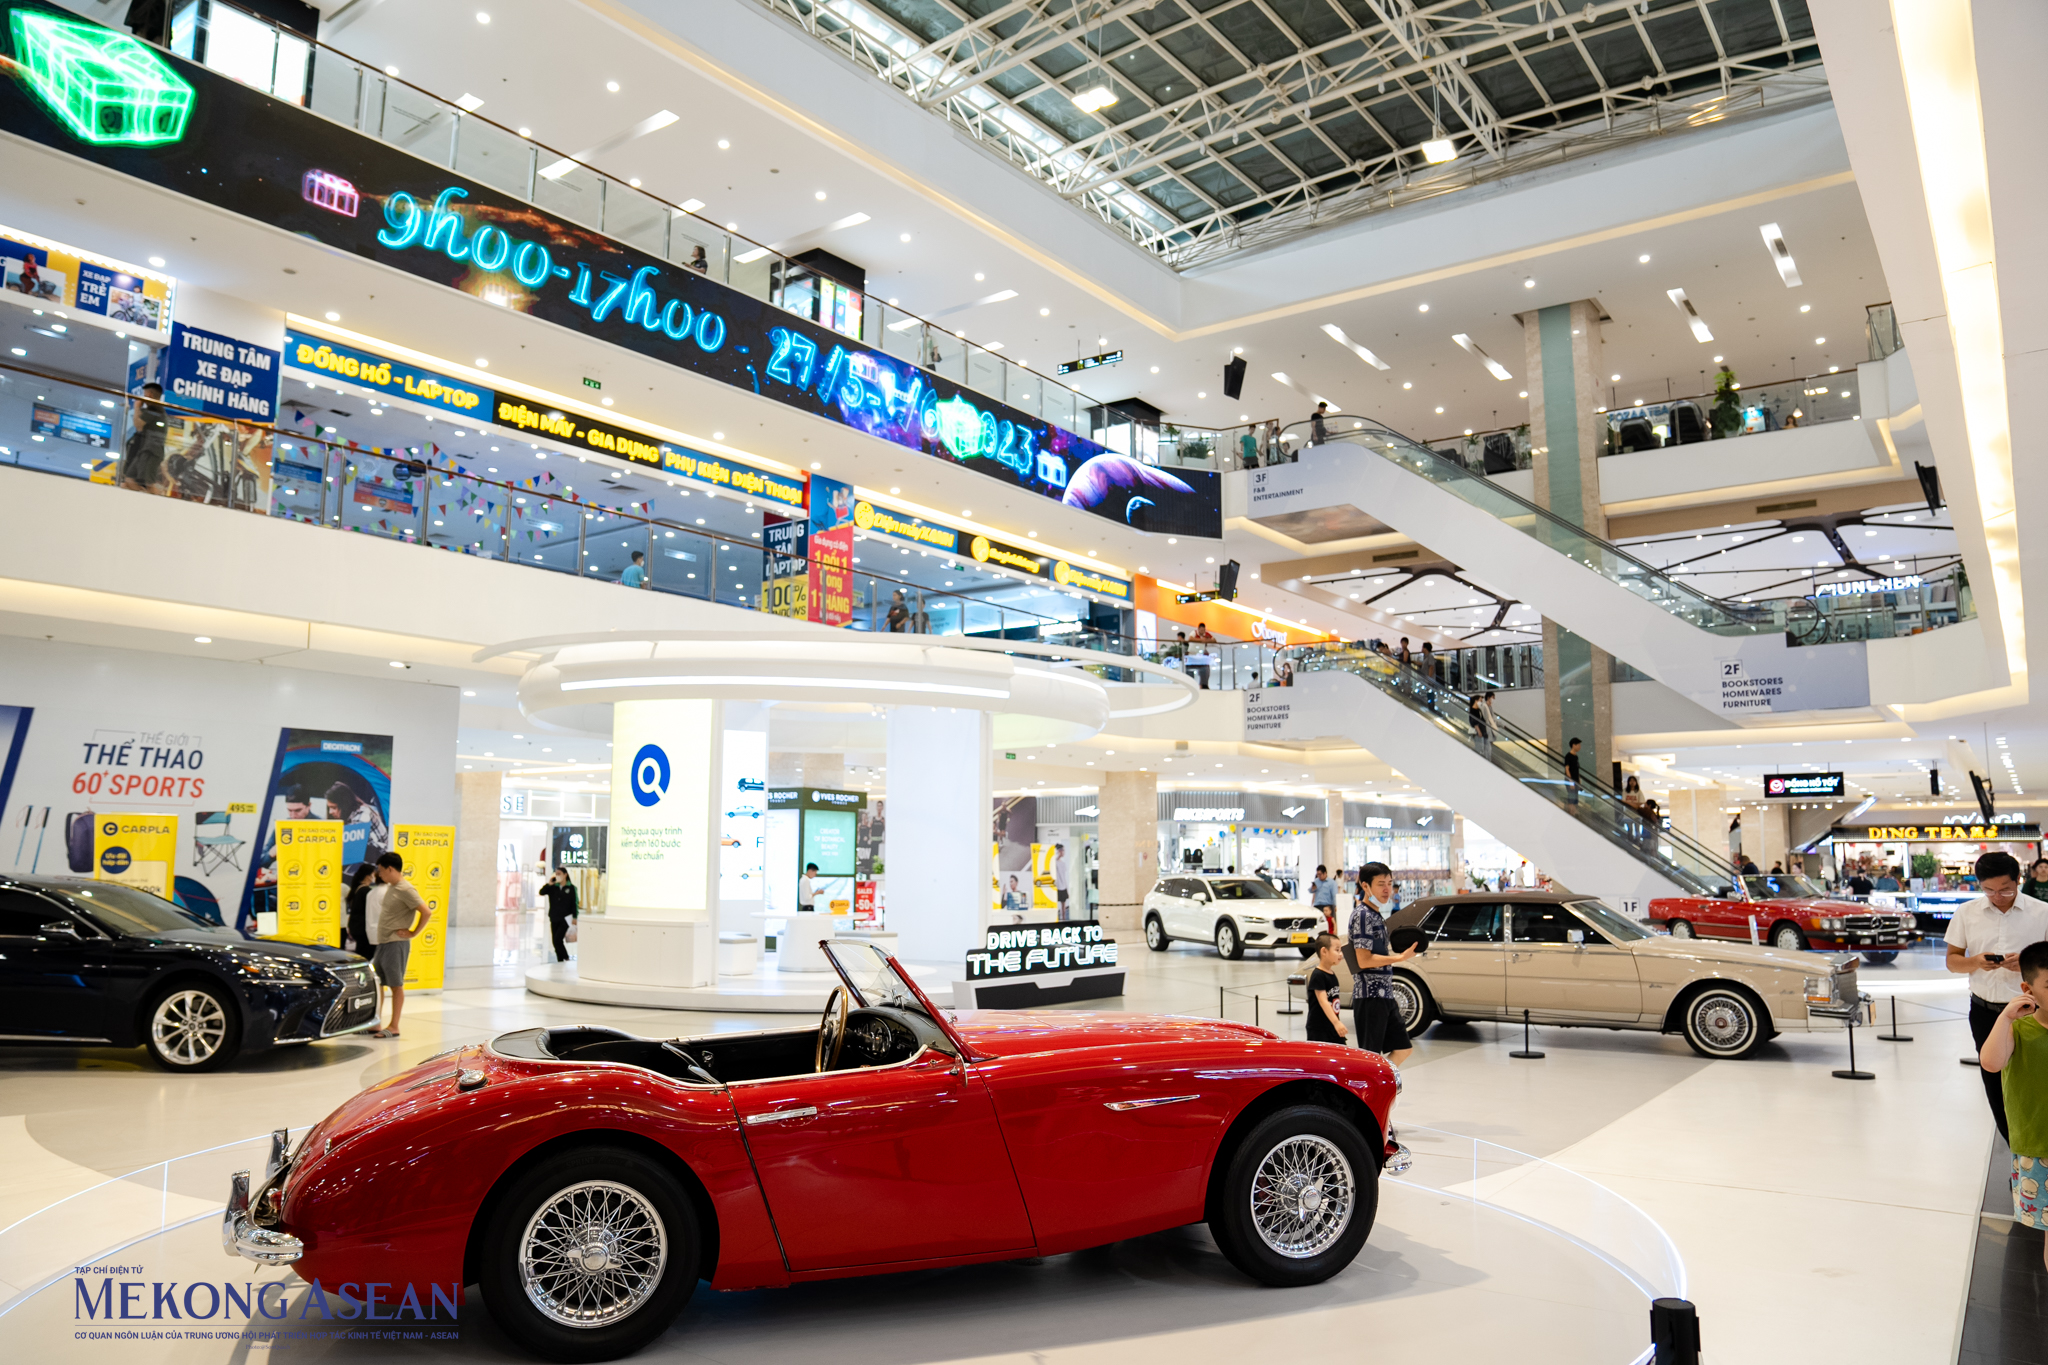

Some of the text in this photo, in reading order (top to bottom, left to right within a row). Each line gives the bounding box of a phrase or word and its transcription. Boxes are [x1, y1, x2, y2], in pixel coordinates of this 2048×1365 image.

[81, 280, 107, 297] TRẺ
[80, 292, 100, 307] EM
[181, 331, 271, 371] TRUNG TÂM
[197, 360, 253, 388] XE ĐẠP
[296, 343, 360, 378] ĐỒNG
[360, 362, 392, 386] HỒ
[405, 375, 480, 410] LAPTOP
[173, 376, 224, 405] CHÍNH
[227, 391, 269, 417] HÃNG
[498, 402, 540, 429] ĐIỆN
[540, 413, 576, 439] MÁY
[587, 428, 616, 451] GIA
[616, 437, 660, 463] DỤNG
[665, 451, 802, 505] PHỤ KIỆN ĐIỆN THOẠI
[1255, 473, 1267, 483] 3F
[1254, 488, 1304, 502] ENTERTAINMENT
[815, 549, 821, 570] 1
[841, 556, 848, 575] 1
[819, 570, 843, 592] tong
[811, 588, 817, 608] 1
[1724, 664, 1740, 675] 2F
[1722, 677, 1783, 688] BOOKSTORES
[1249, 693, 1261, 703] 2F
[1722, 687, 1782, 698] HOMEWARES
[1247, 704, 1290, 714] BOOKSTORES
[1723, 698, 1772, 708] FURNITURE
[1247, 713, 1289, 722] HOMEWARES
[1247, 722, 1281, 730] FURNITURE
[140, 731, 190, 747] THẾ GIỚI
[83, 738, 203, 770] THỂ THAO
[108, 774, 205, 799] SPORTS
[820, 793, 836, 801] YVES
[836, 794, 859, 803] ROCHER
[231, 804, 245, 813] 495
[122, 825, 170, 834] CARPLA
[638, 828, 649, 837] qua
[650, 828, 663, 837] quy
[1868, 826, 1918, 839] DING
[1924, 826, 1967, 839] TEA
[413, 839, 449, 847] CARPLA
[648, 839, 660, 848] 160
[661, 838, 681, 847] bước
[857, 887, 873, 895] SALES
[1623, 902, 1638, 912] 1F
[987, 925, 1103, 950] DRIVE BACK TO
[966, 943, 1119, 976] THE FUTURE
